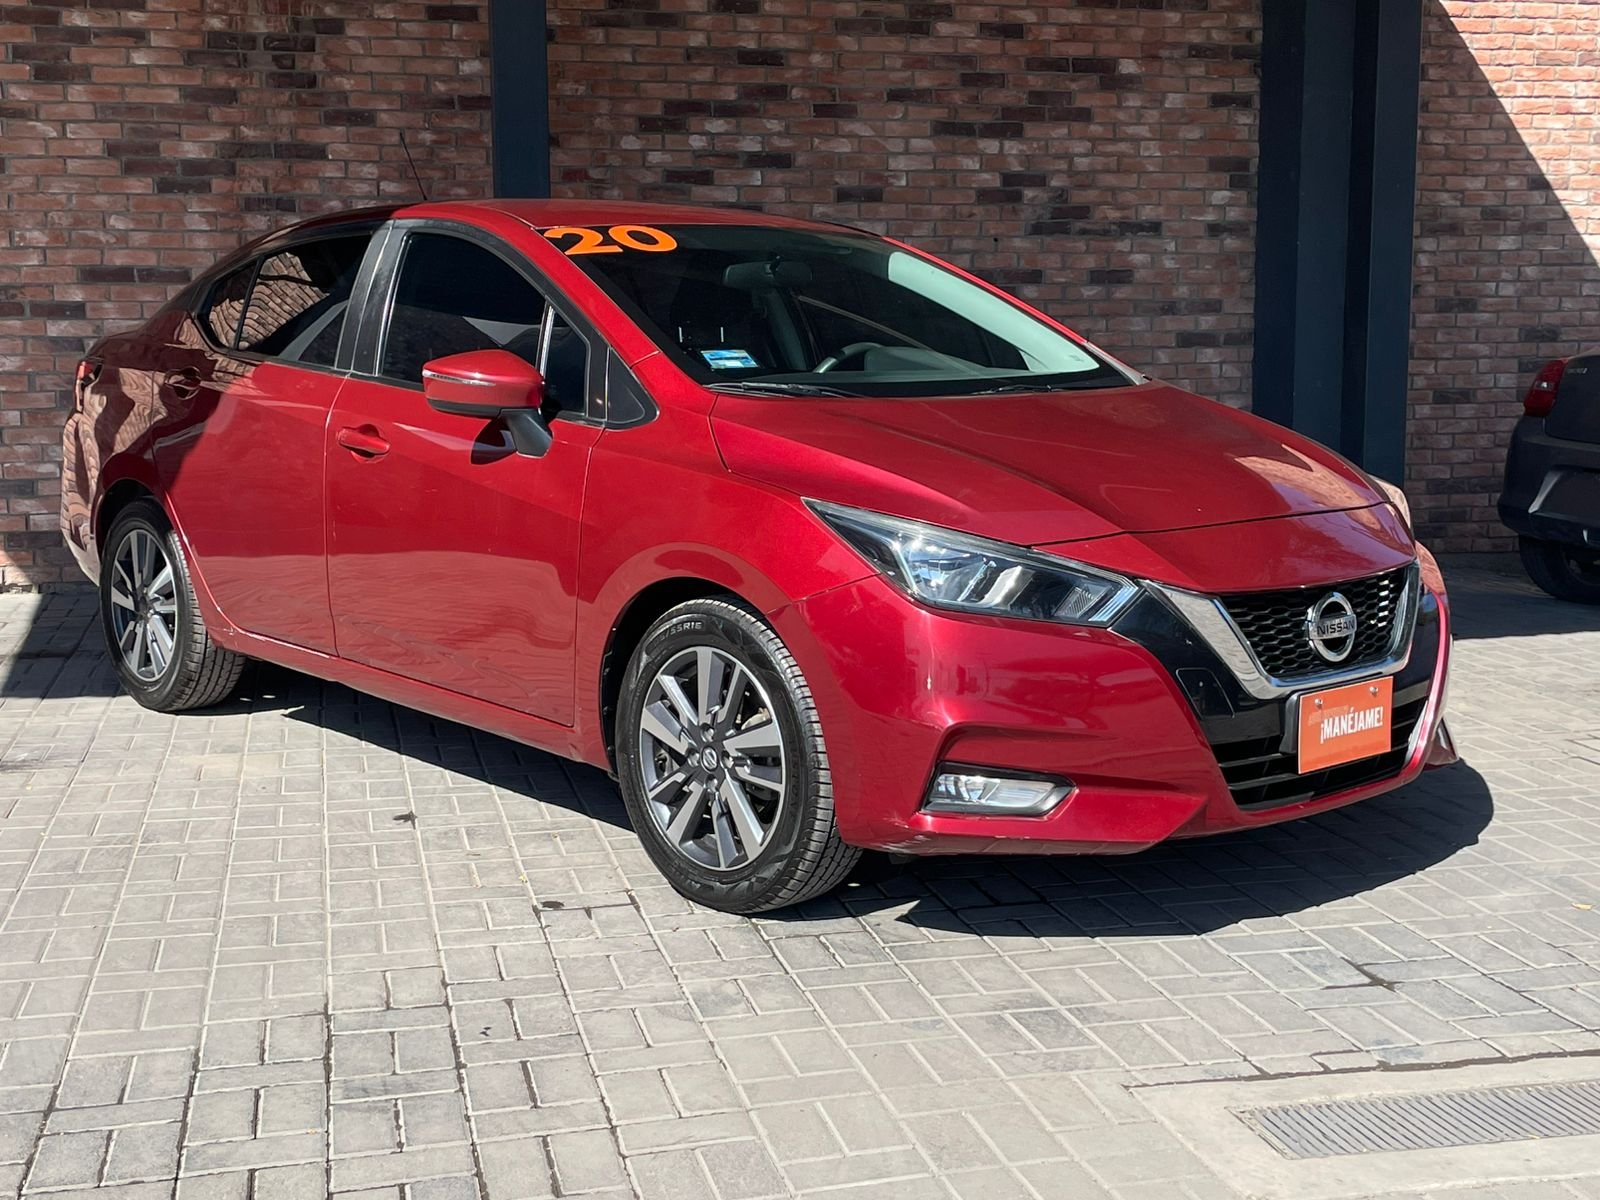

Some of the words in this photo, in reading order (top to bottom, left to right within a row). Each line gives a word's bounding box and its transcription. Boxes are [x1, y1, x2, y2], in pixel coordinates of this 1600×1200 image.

[543, 224, 678, 256] 20
[1316, 620, 1354, 635] NISSAN
[1320, 706, 1384, 744] ¡MANÉJAME!
